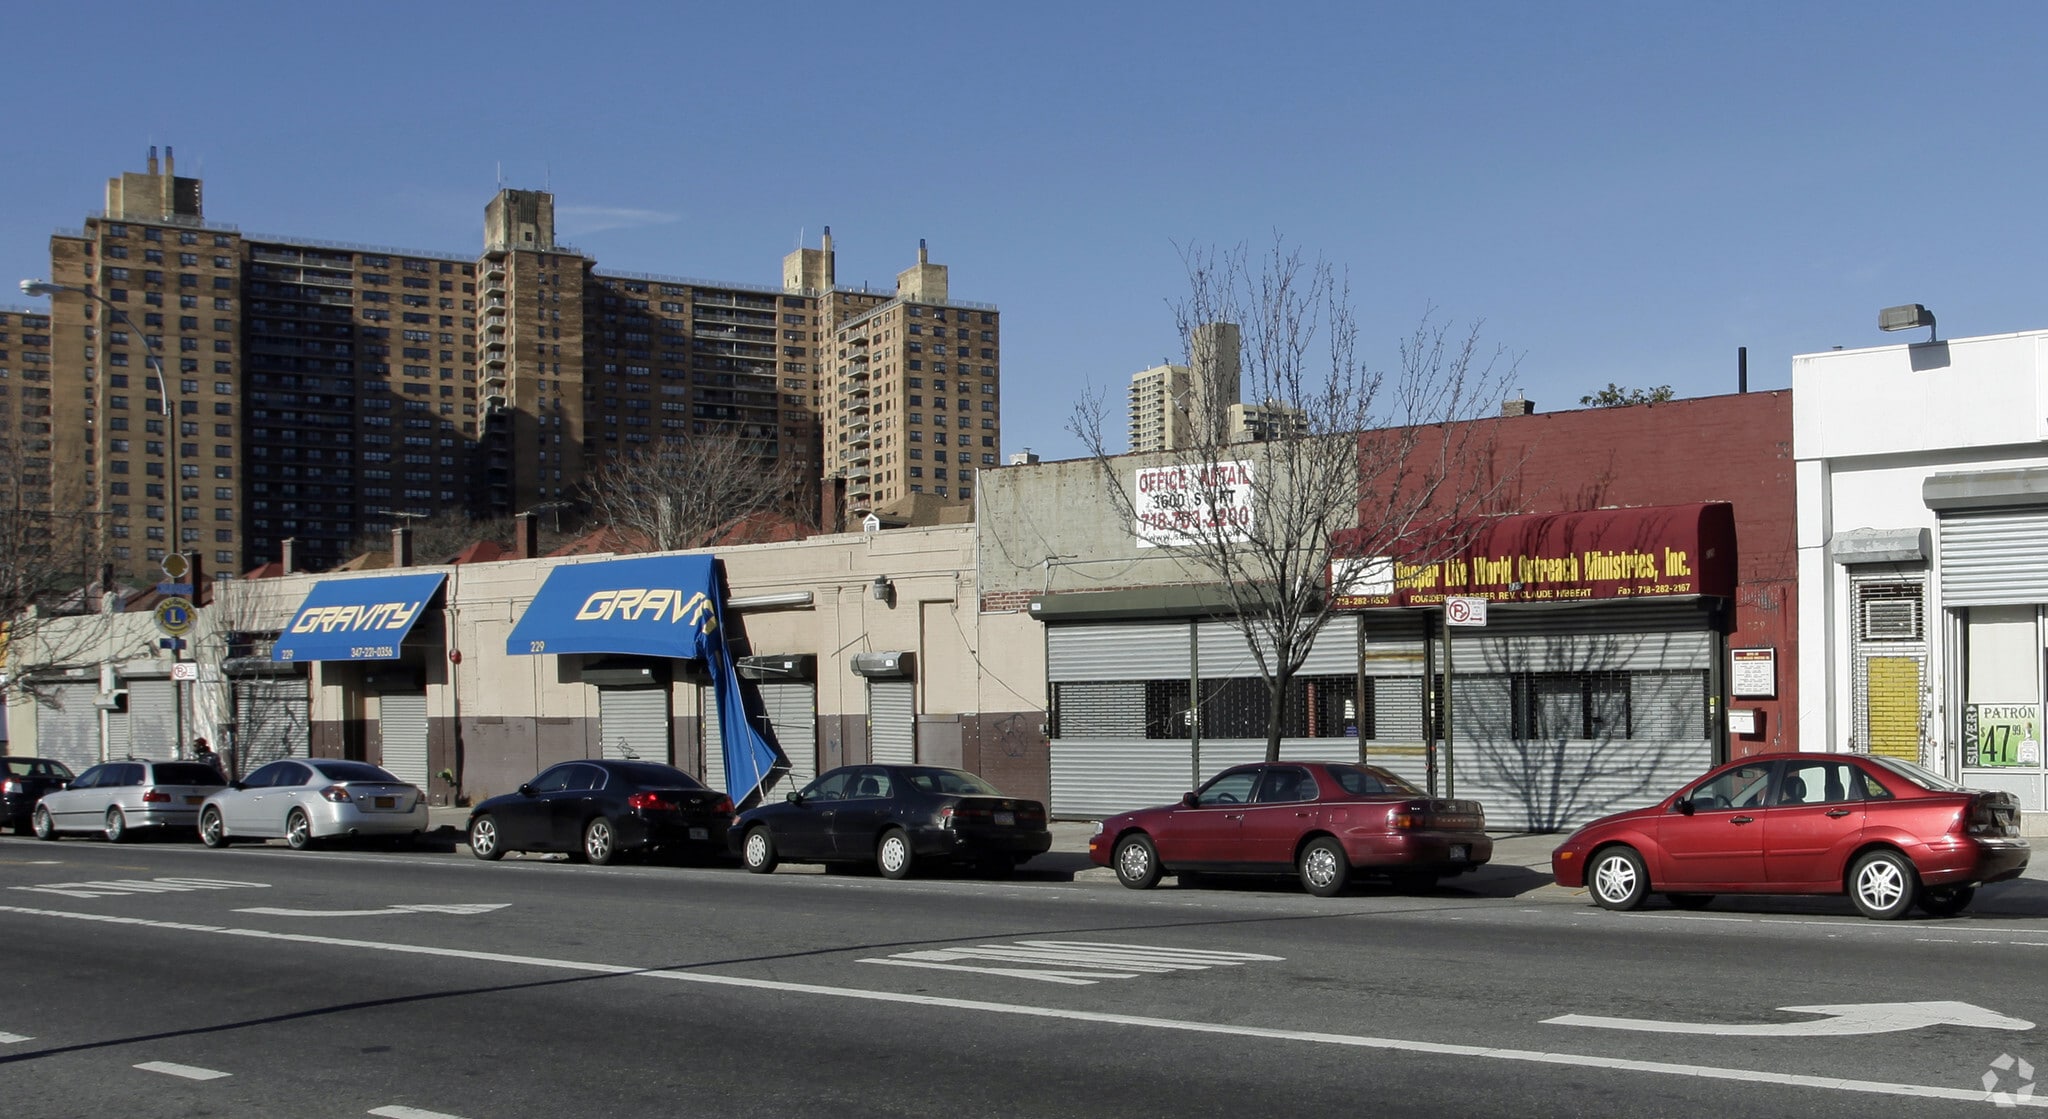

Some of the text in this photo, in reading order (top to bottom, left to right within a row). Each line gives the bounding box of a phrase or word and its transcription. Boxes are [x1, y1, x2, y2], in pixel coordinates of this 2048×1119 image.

[1396, 546, 1692, 592] Deeper Life World Outreach Ministries, Inc.
[291, 602, 420, 633] GRAVITY
[530, 641, 545, 652] 229
[1984, 706, 2036, 719] PATRÓN
[1965, 712, 1978, 765] SILVER
